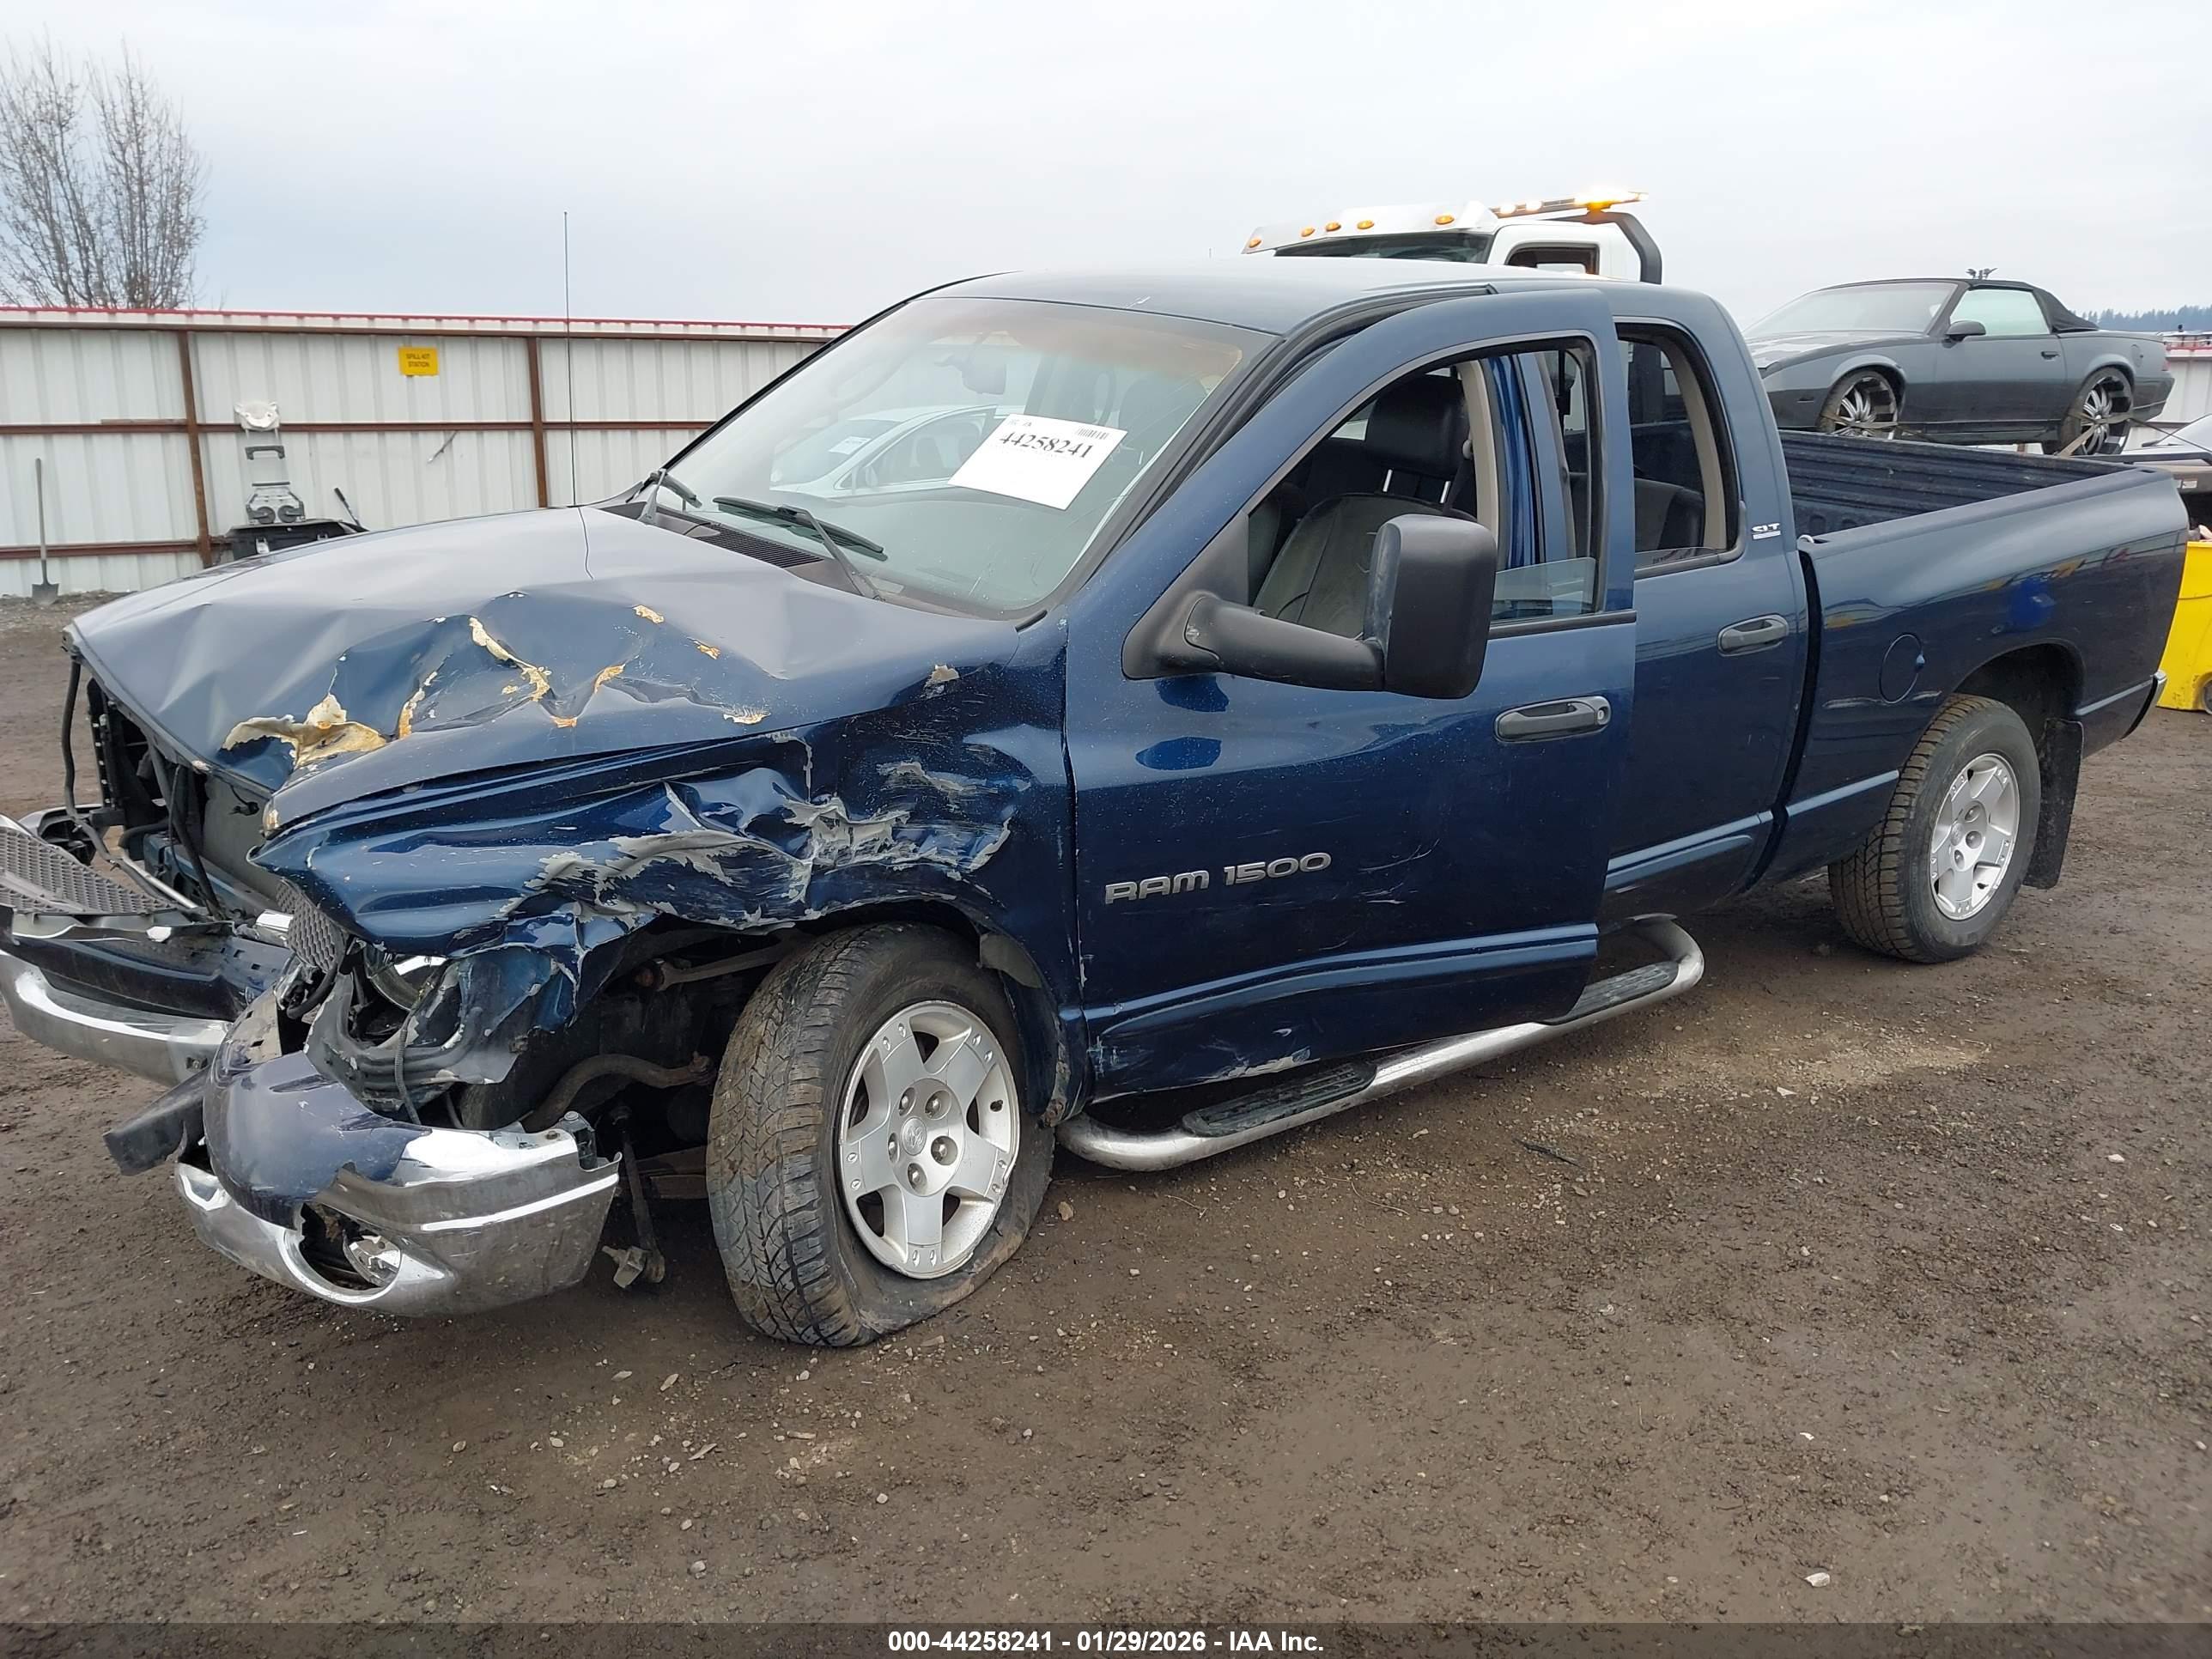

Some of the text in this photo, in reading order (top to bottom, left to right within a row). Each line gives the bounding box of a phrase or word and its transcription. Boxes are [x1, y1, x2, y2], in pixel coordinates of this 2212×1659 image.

[999, 432, 1093, 458] 44258241
[1752, 522, 1780, 532] SLT
[1104, 852, 1332, 904] RAM 1500
